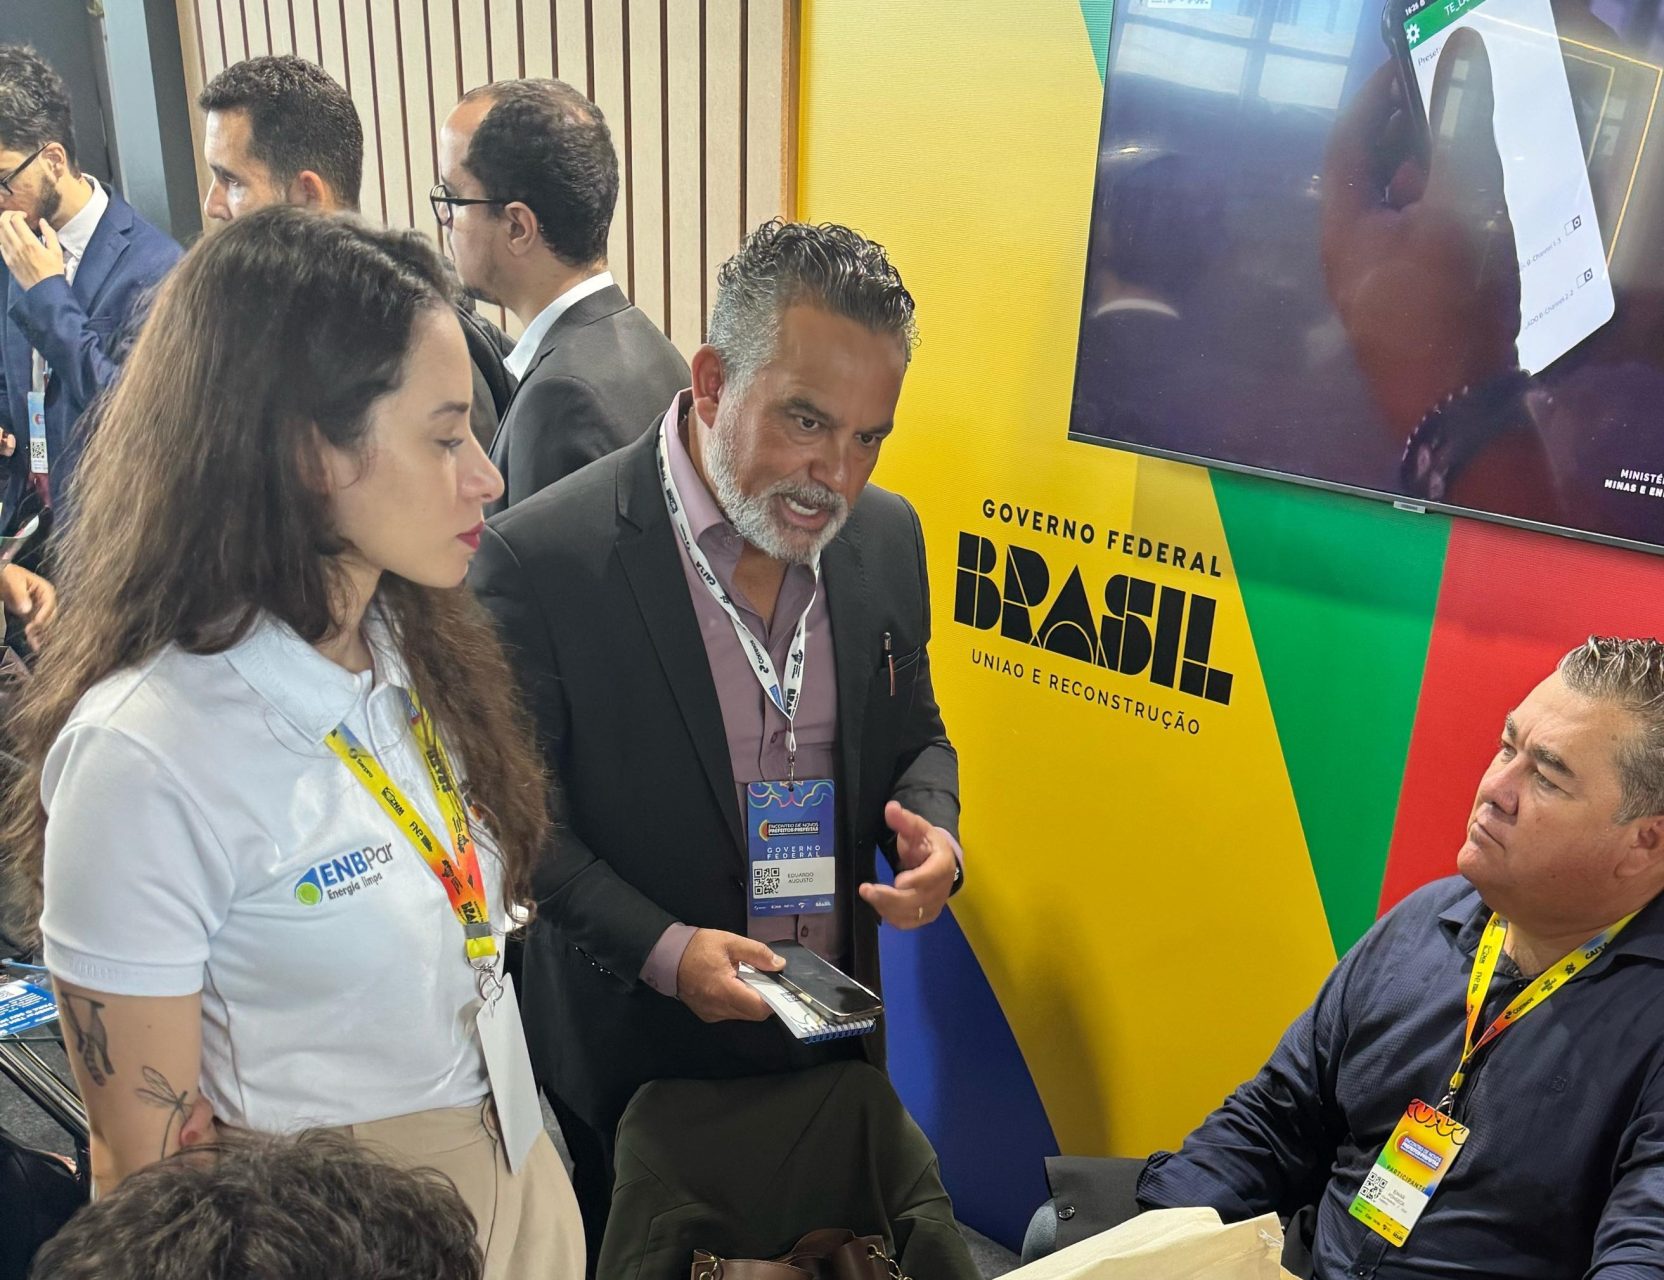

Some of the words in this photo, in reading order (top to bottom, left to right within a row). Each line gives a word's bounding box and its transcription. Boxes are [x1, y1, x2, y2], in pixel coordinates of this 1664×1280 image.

[1604, 479, 1637, 493] MINAS
[1639, 485, 1647, 495] E
[1649, 487, 1664, 498] EN
[1620, 468, 1664, 485] MINISTÉ
[982, 499, 1095, 545] GOVERNO
[1107, 530, 1222, 578] FEDERAL
[953, 531, 1234, 706] BRASIL
[1032, 668, 1041, 684] E
[1049, 673, 1201, 735] RECONSTRUÇÃO
[767, 844, 821, 854] GOVERNO
[767, 852, 820, 860] FEDERAL
[319, 842, 393, 887] ENBPar
[327, 881, 361, 900] Energia
[361, 872, 383, 888] limpa
